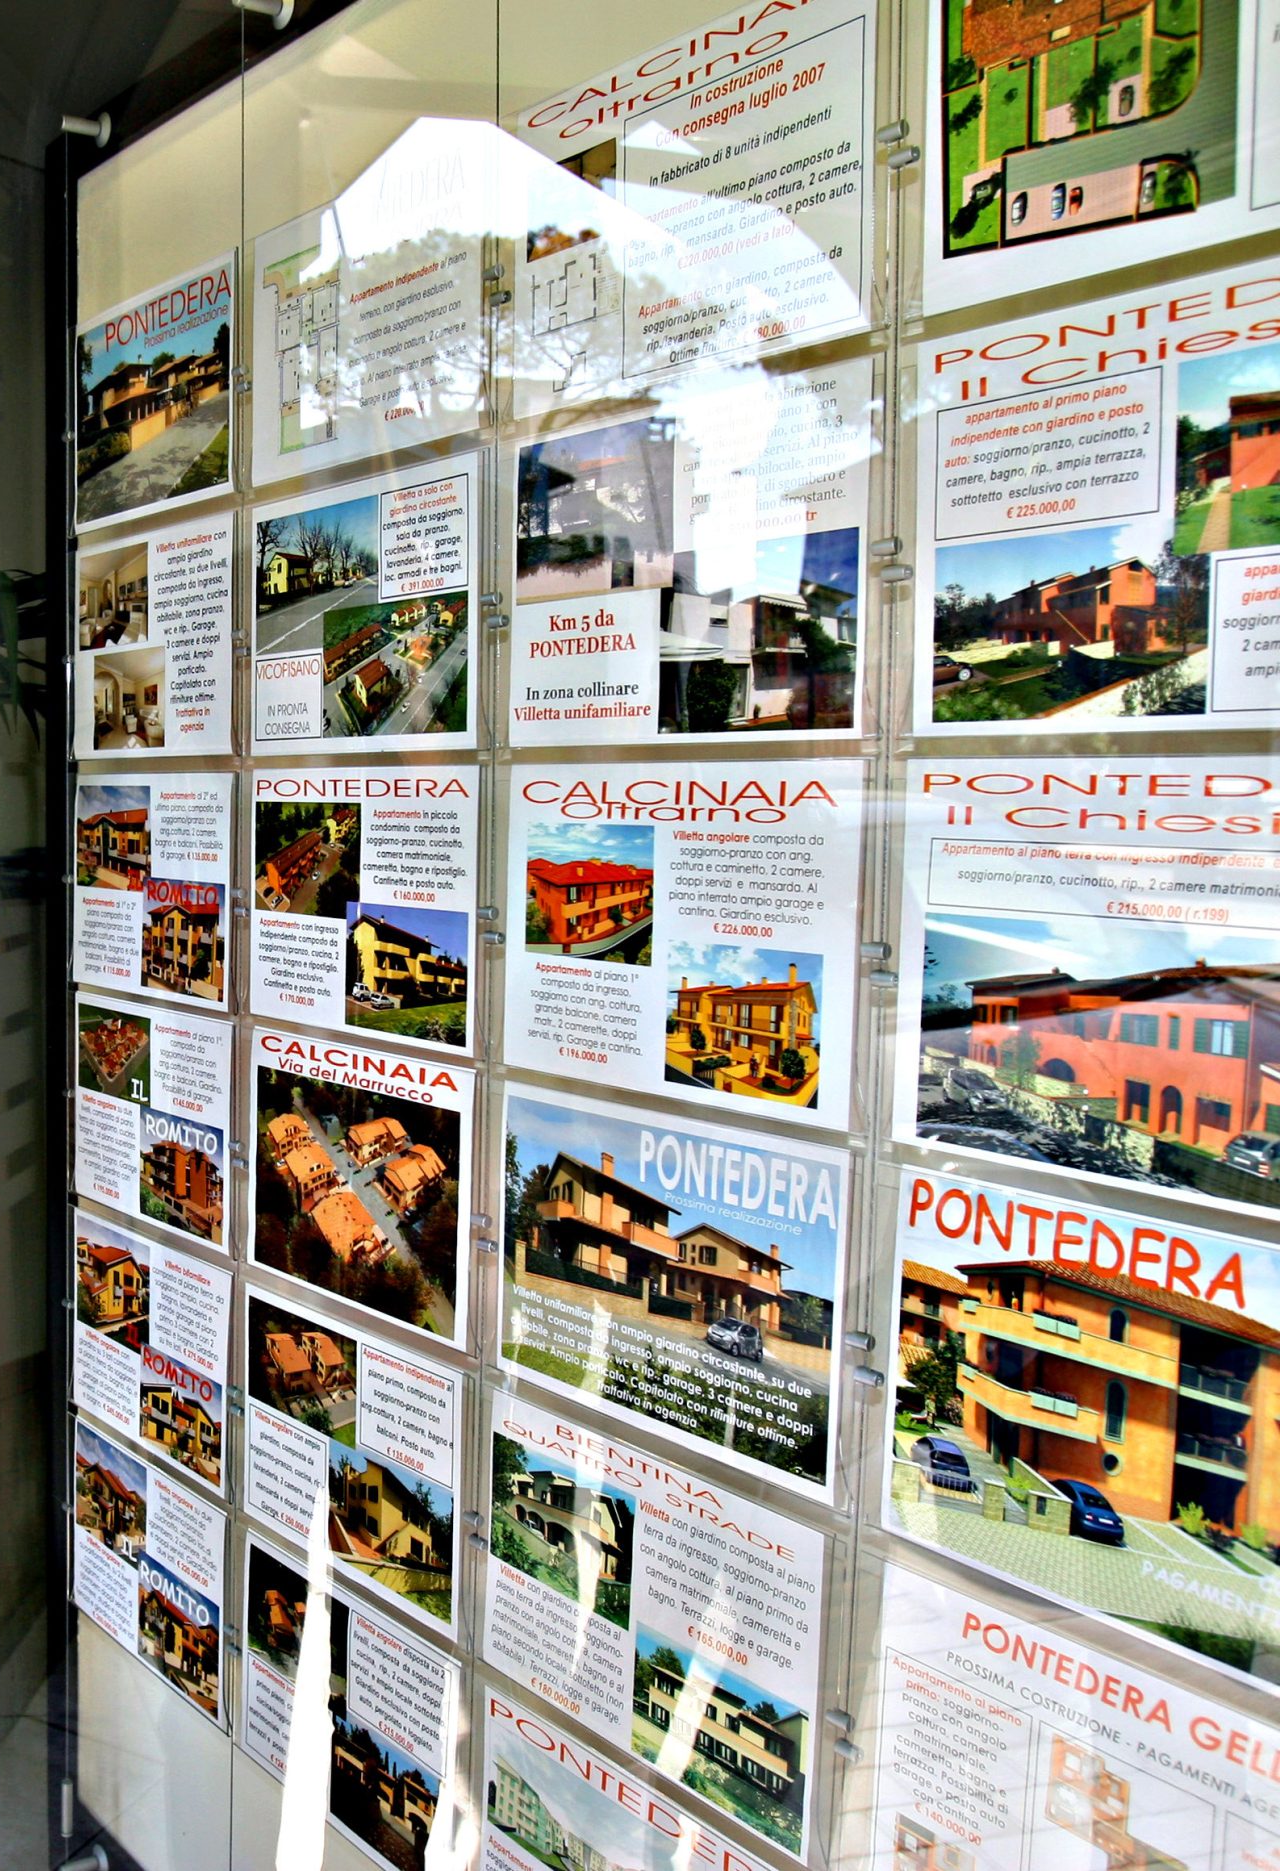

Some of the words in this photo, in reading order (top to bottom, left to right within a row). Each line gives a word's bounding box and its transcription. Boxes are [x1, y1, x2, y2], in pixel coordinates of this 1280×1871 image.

[690, 93, 702, 110] In
[705, 58, 784, 103] costruzione
[697, 100, 745, 131] consegna
[749, 81, 788, 109] luglio
[792, 62, 826, 92] 2007
[649, 175, 659, 187] In
[660, 156, 710, 185] fabbricato
[712, 148, 723, 164] di
[724, 145, 732, 159] 8
[733, 134, 760, 156] unità
[762, 104, 832, 145] indipendenti
[105, 268, 232, 353] PONTEDERA
[961, 376, 987, 401] Il
[964, 400, 1040, 426] appartamento
[1041, 395, 1054, 409] al
[1054, 391, 1090, 410] primo
[1092, 383, 1128, 402] piano
[950, 425, 1020, 447] indipendente
[1021, 421, 1043, 434] con
[1045, 411, 1095, 433] giardino
[1097, 410, 1106, 421] e
[1107, 402, 1144, 422] posto
[944, 455, 971, 468] auto:
[972, 438, 1075, 464] soggiorno/pranzo,
[1078, 426, 1138, 446] cucinotto,
[1142, 421, 1150, 435] 2
[945, 473, 986, 488] camere,
[989, 466, 1027, 482] bagno,
[1030, 461, 1053, 477] rip.,
[1055, 454, 1091, 471] ampia
[1094, 447, 1146, 464] terrazza,
[388, 503, 418, 518] giardino
[418, 493, 457, 510] circostante
[950, 490, 1003, 508] sottotetto
[1008, 481, 1063, 499] esclusivo
[1064, 478, 1087, 491] con
[1090, 470, 1139, 487] terrazzo
[1006, 506, 1014, 519] €
[1016, 497, 1076, 518] 225.000,00
[548, 614, 577, 632] Km
[581, 614, 590, 632] 5
[594, 608, 615, 627] da
[529, 632, 636, 659] PONTEDERA
[256, 659, 320, 681] VICOPISANO
[267, 704, 276, 717] IN
[276, 702, 309, 717] PRONTA
[526, 686, 540, 701] In
[542, 687, 574, 700] zona
[577, 680, 639, 698] collinare
[264, 720, 311, 736] CONSEGNA
[513, 705, 560, 721] Villetta
[563, 701, 651, 719] unifamiliare
[255, 778, 470, 798] PONTEDERA
[522, 780, 838, 808] CALCINAIA
[922, 773, 1273, 797] PONTED
[372, 809, 422, 820] Appartamento
[422, 809, 429, 819] in
[430, 809, 458, 821] piccolo
[561, 800, 787, 824] Oltrarno
[947, 805, 972, 826] Il
[672, 830, 705, 842] Villetta
[705, 831, 751, 845] angolare
[752, 833, 806, 846] composta
[808, 834, 824, 846] da
[147, 879, 219, 905] ROMITO
[393, 889, 398, 900] €
[399, 890, 436, 903] 160.000,00
[957, 869, 1056, 887] soggiorno/pranzo,
[1058, 873, 1118, 890] cucinotto,
[1119, 877, 1145, 893] rip.,
[1148, 877, 1156, 891] 2
[1159, 881, 1207, 893] camere
[713, 922, 720, 933] €
[721, 923, 773, 938] 226.000,00
[260, 1035, 458, 1092] CALCINAIA
[277, 1056, 303, 1074] Via
[309, 1065, 337, 1082] del
[343, 1071, 434, 1104] Marrucco
[131, 1078, 149, 1102] IL
[145, 1114, 218, 1156] ROMITO
[639, 1129, 837, 1230] PONTEDERA
[664, 1191, 716, 1217] Prossima
[718, 1204, 802, 1236] realizzazione
[909, 1178, 1246, 1309] PONTEDERA
[512, 1284, 542, 1307] Villetta
[543, 1296, 595, 1325] unifamiliare
[621, 1321, 652, 1345] ampio
[654, 1331, 699, 1359] giardino
[701, 1348, 768, 1384] circostante,
[771, 1371, 785, 1387] su
[787, 1373, 812, 1397] due
[143, 1349, 213, 1403] ROMITO
[596, 1381, 640, 1408] Trattativa
[641, 1396, 653, 1412] in
[655, 1402, 697, 1429] agenzia
[556, 1424, 723, 1509] BIENTINA
[503, 1419, 643, 1489] QUATTRO
[665, 1493, 794, 1563] STRADE
[121, 1535, 138, 1563] IL
[639, 1498, 670, 1524] Villetta
[671, 1517, 688, 1532] con
[689, 1525, 727, 1550] giardino
[728, 1544, 774, 1574] composta
[775, 1567, 786, 1580] al
[786, 1573, 815, 1594] piano
[139, 1560, 210, 1627] ROMITO
[687, 1625, 696, 1639] €
[696, 1630, 748, 1666] 165.000,00
[962, 1611, 1172, 1733] PONTEDERA
